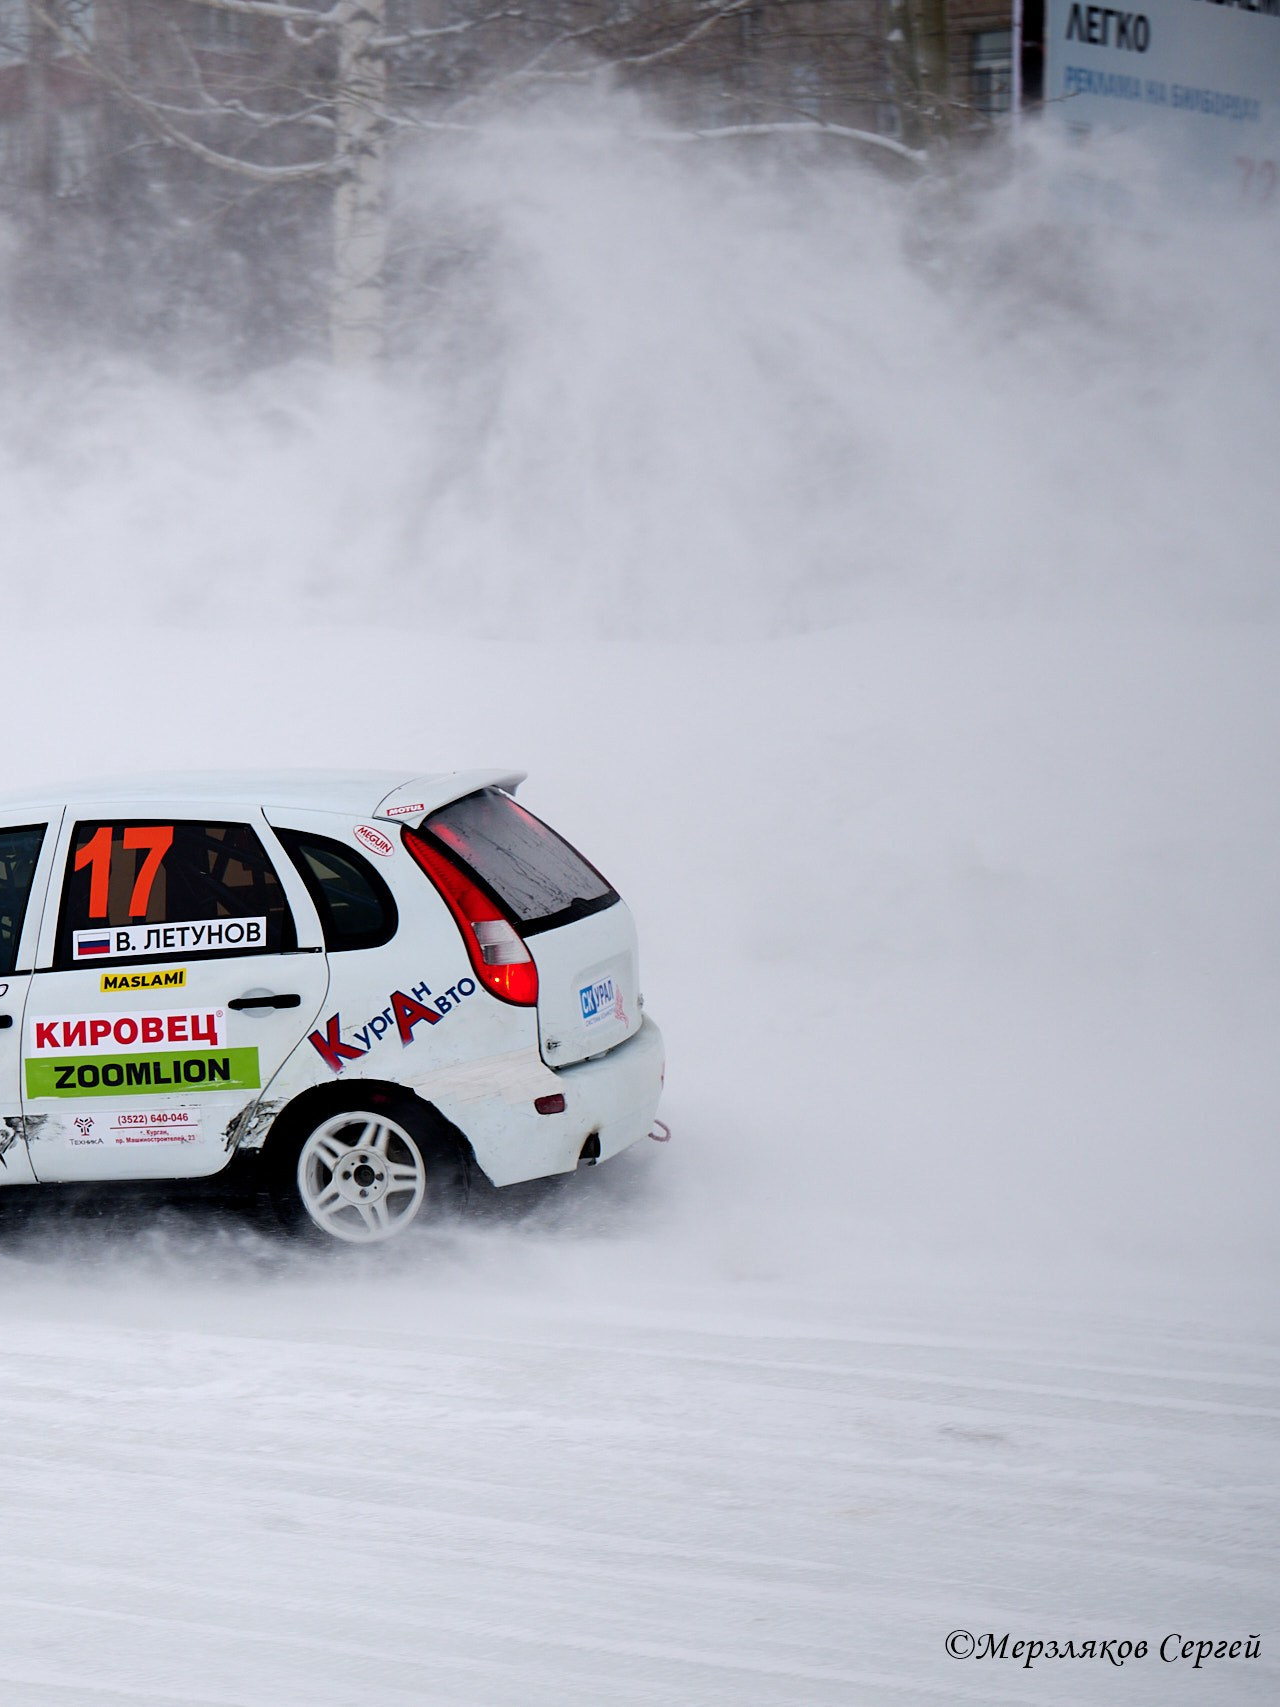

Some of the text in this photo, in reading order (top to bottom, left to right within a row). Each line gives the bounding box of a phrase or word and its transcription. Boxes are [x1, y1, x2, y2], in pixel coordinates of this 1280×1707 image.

[1066, 4, 1151, 53] ЛЕГКО
[388, 804, 423, 816] MOTUL
[357, 826, 392, 853] MEGUIN
[74, 825, 175, 919] 17
[115, 922, 261, 951] В. ЛЕТУНОВ
[103, 971, 184, 990] MASLAMI
[581, 979, 615, 1014] СК УРАЛ
[54, 1057, 231, 1089] ZOOMLION
[117, 1112, 189, 1126] (3522) 640-046
